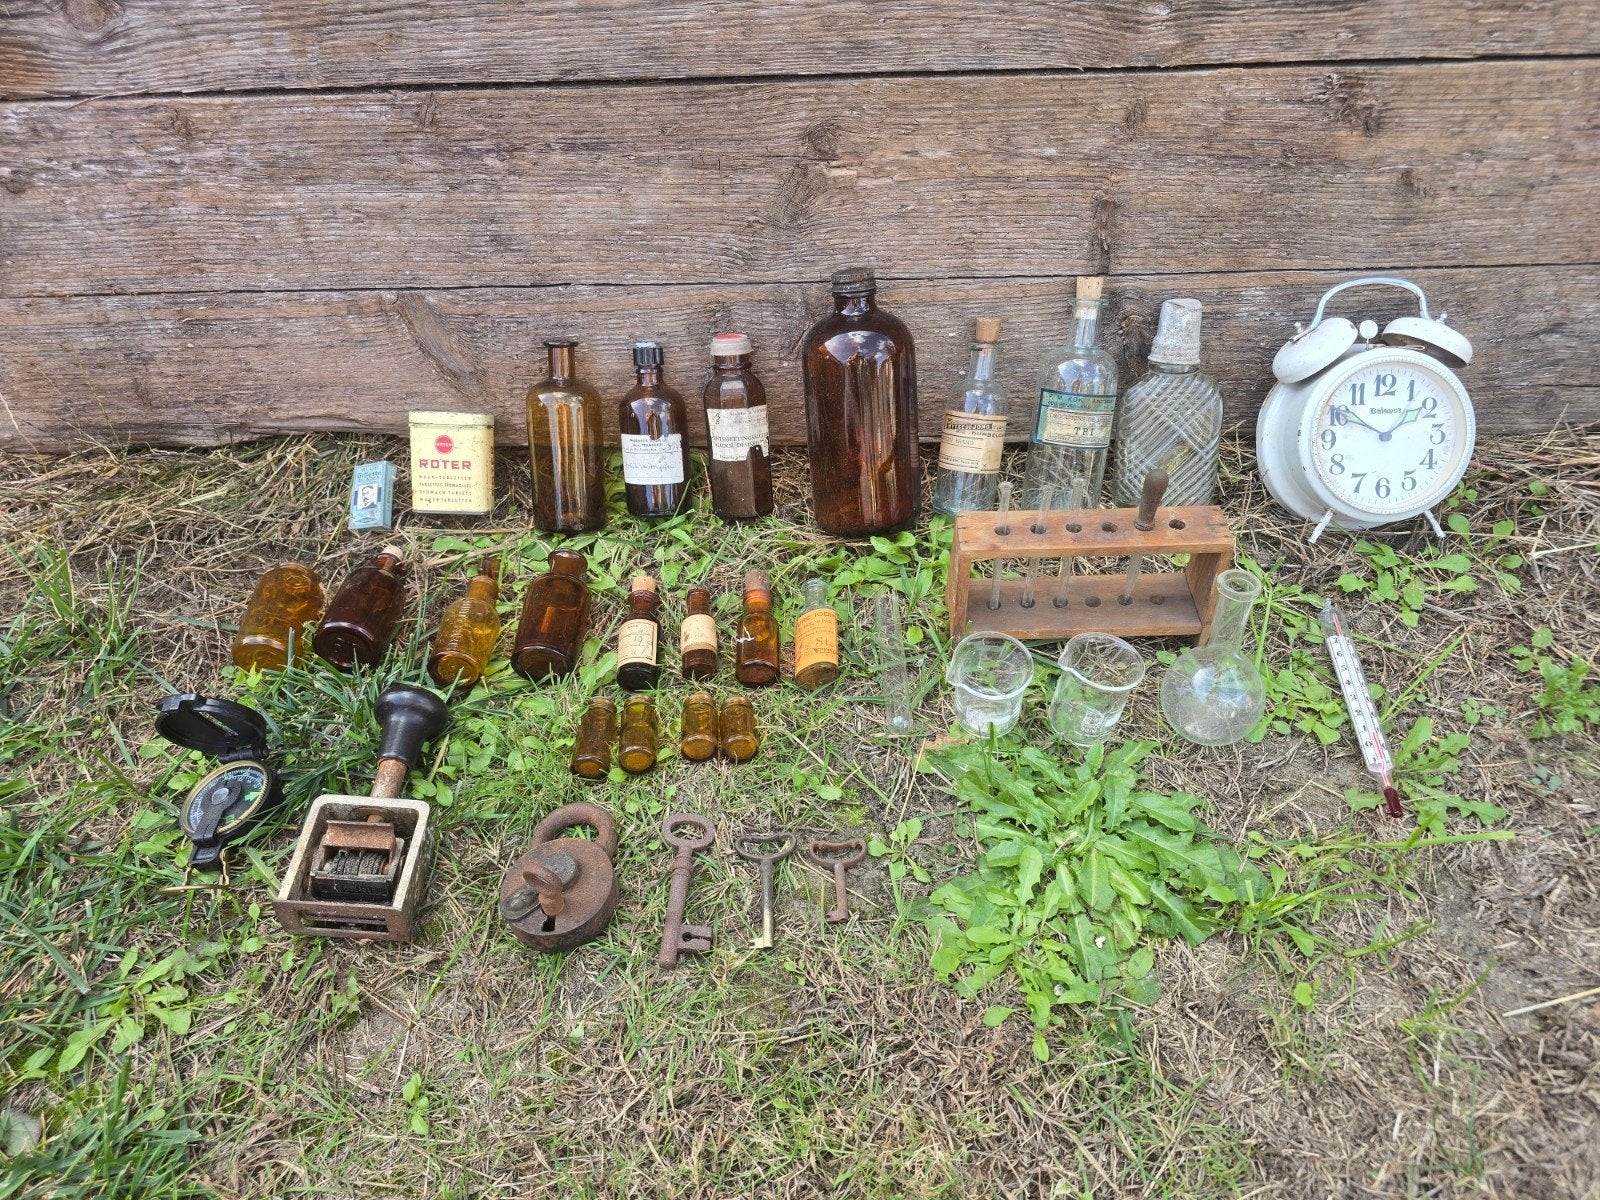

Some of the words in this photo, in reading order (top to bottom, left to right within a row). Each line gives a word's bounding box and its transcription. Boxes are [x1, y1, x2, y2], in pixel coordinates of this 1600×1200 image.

[1348, 383, 1366, 406] 11
[1373, 374, 1397, 397] 12
[1405, 379, 1416, 402] 1
[1328, 404, 1350, 426] 10
[1421, 396, 1438, 418] 2
[1073, 426, 1094, 436] TRI
[1320, 429, 1337, 451] 9
[1429, 424, 1446, 445] 3
[418, 459, 472, 470] ROTER
[1328, 453, 1346, 475] 8
[1419, 448, 1438, 470] 4
[1351, 472, 1368, 494] 7
[1374, 477, 1391, 499] 6
[1401, 469, 1417, 491] 5
